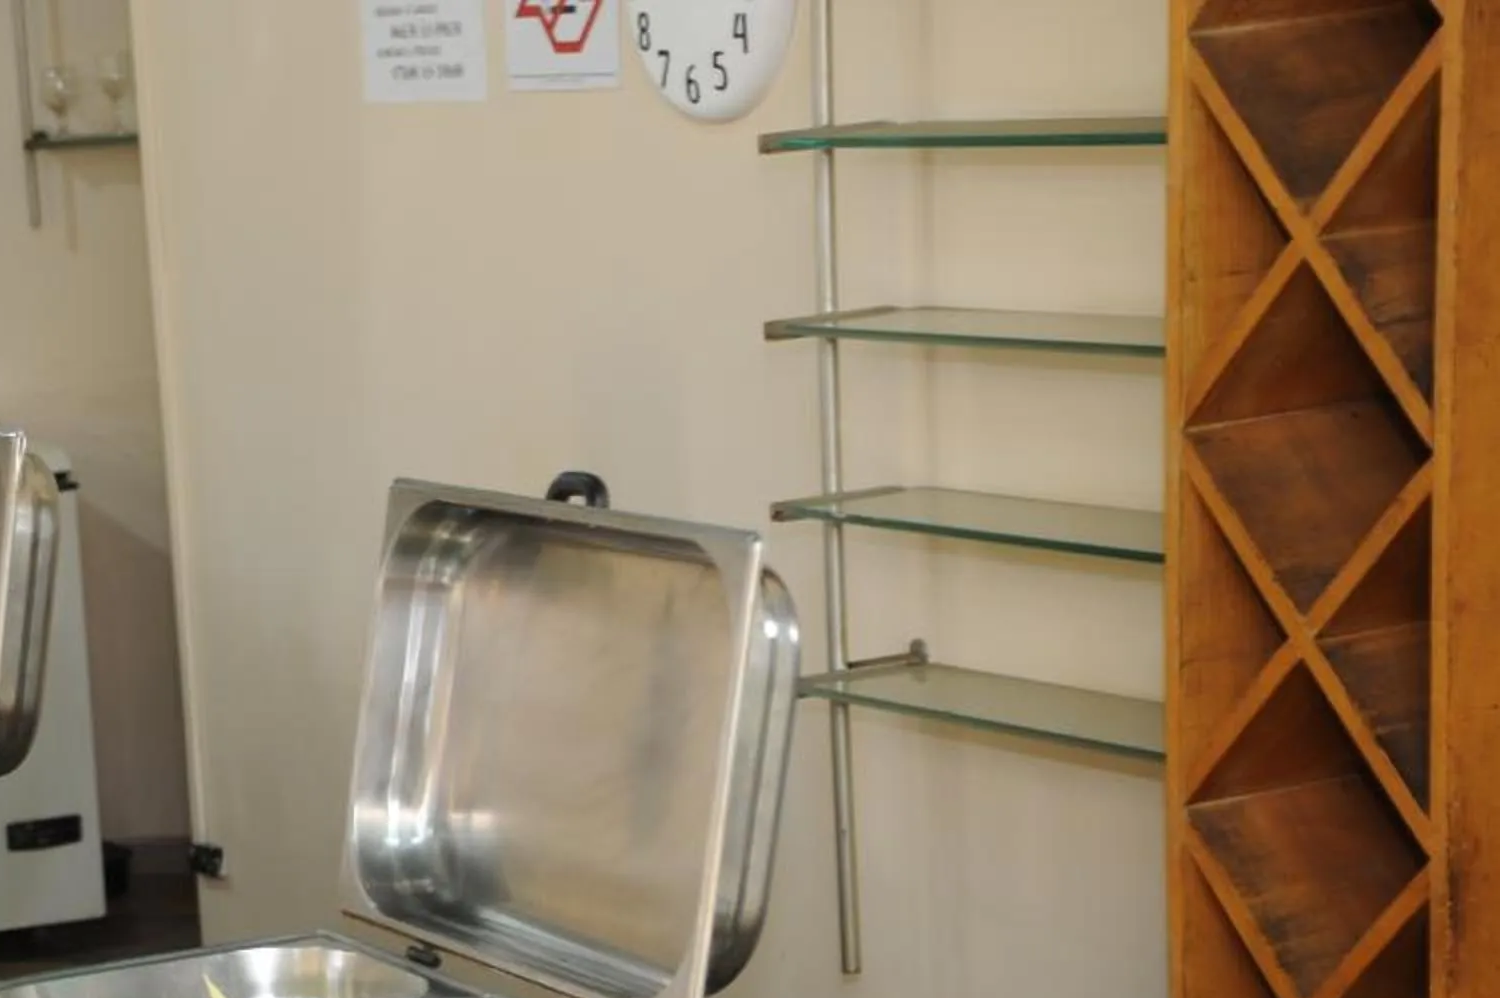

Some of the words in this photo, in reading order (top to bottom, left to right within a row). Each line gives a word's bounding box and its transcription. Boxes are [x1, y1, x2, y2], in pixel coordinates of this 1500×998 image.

[638, 12, 651, 51] 8
[733, 12, 749, 54] 4
[657, 49, 670, 88] 7
[686, 64, 701, 104] 6
[712, 51, 728, 91] 5
